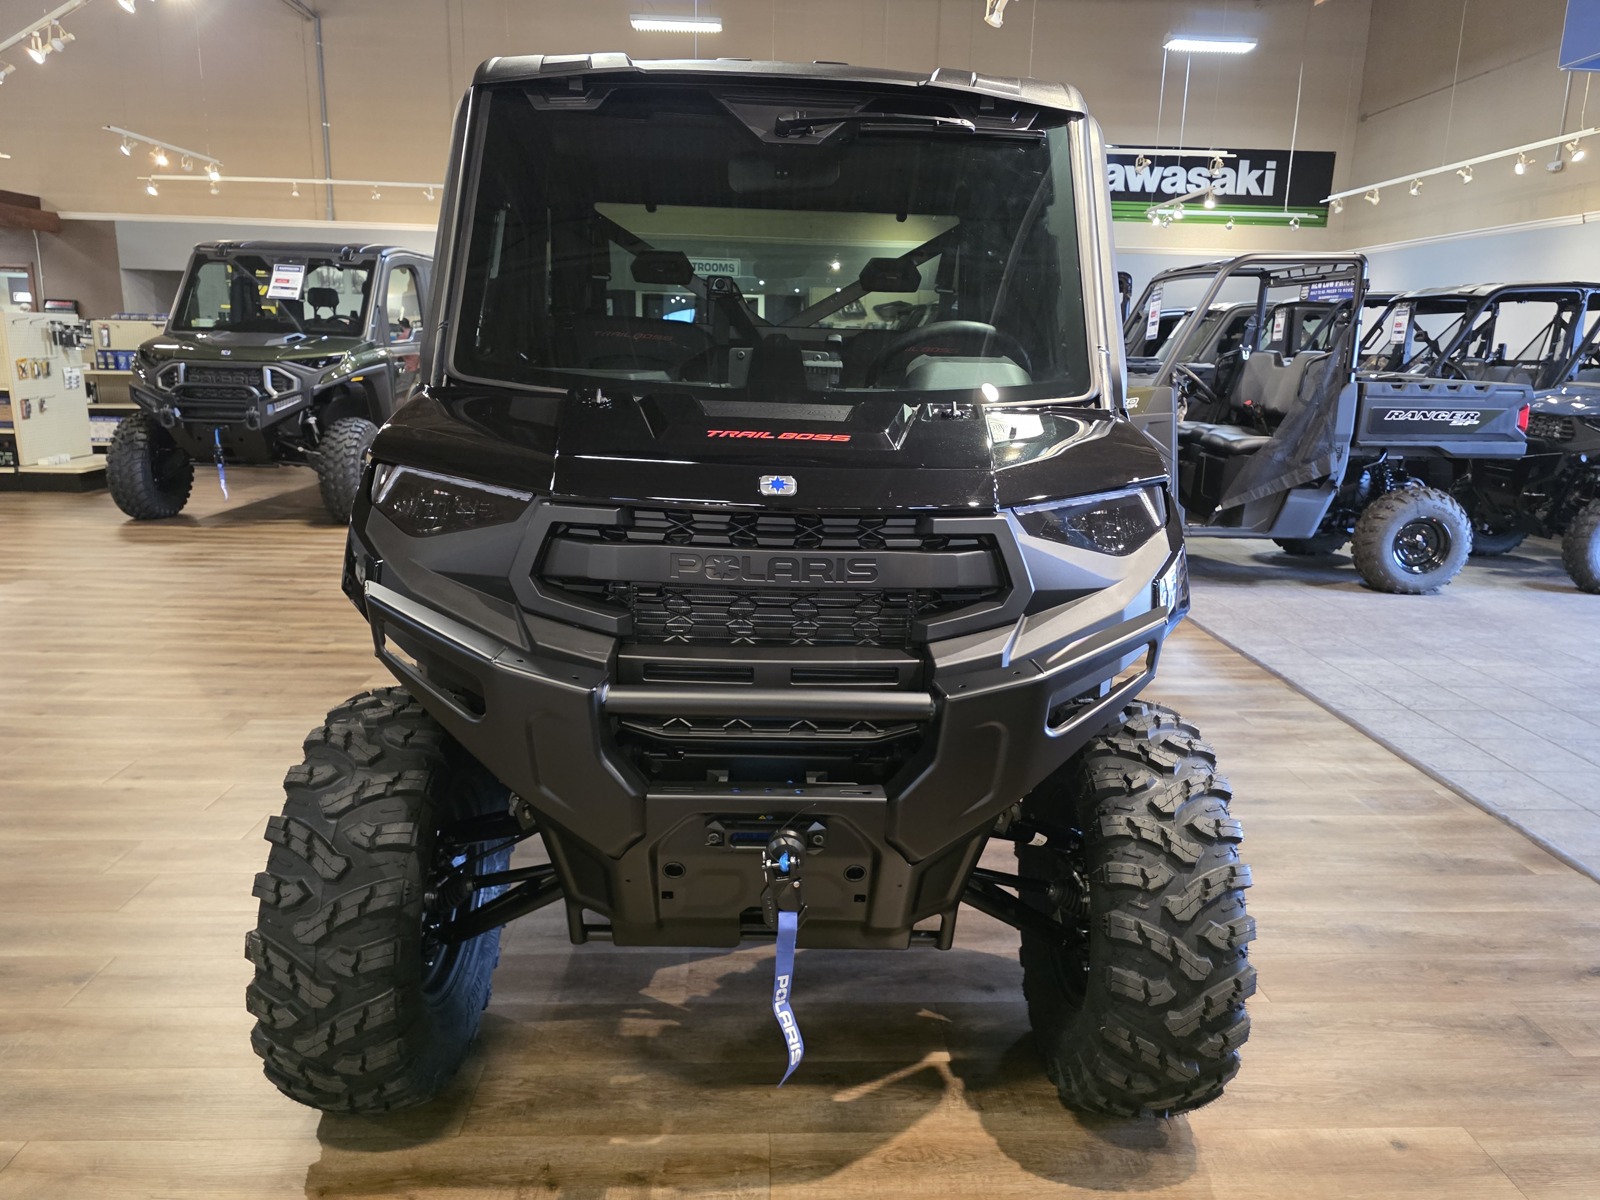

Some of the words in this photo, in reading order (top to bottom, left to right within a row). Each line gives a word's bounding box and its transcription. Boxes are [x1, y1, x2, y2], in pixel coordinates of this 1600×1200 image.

[1107, 160, 1277, 196] awasaki
[692, 262, 735, 273] TROOMS
[1384, 410, 1480, 421] RANGER
[707, 430, 775, 439] TRAIL
[777, 432, 851, 442] BOSS
[669, 552, 879, 584] POLARIS
[774, 974, 801, 1065] POLARIS
